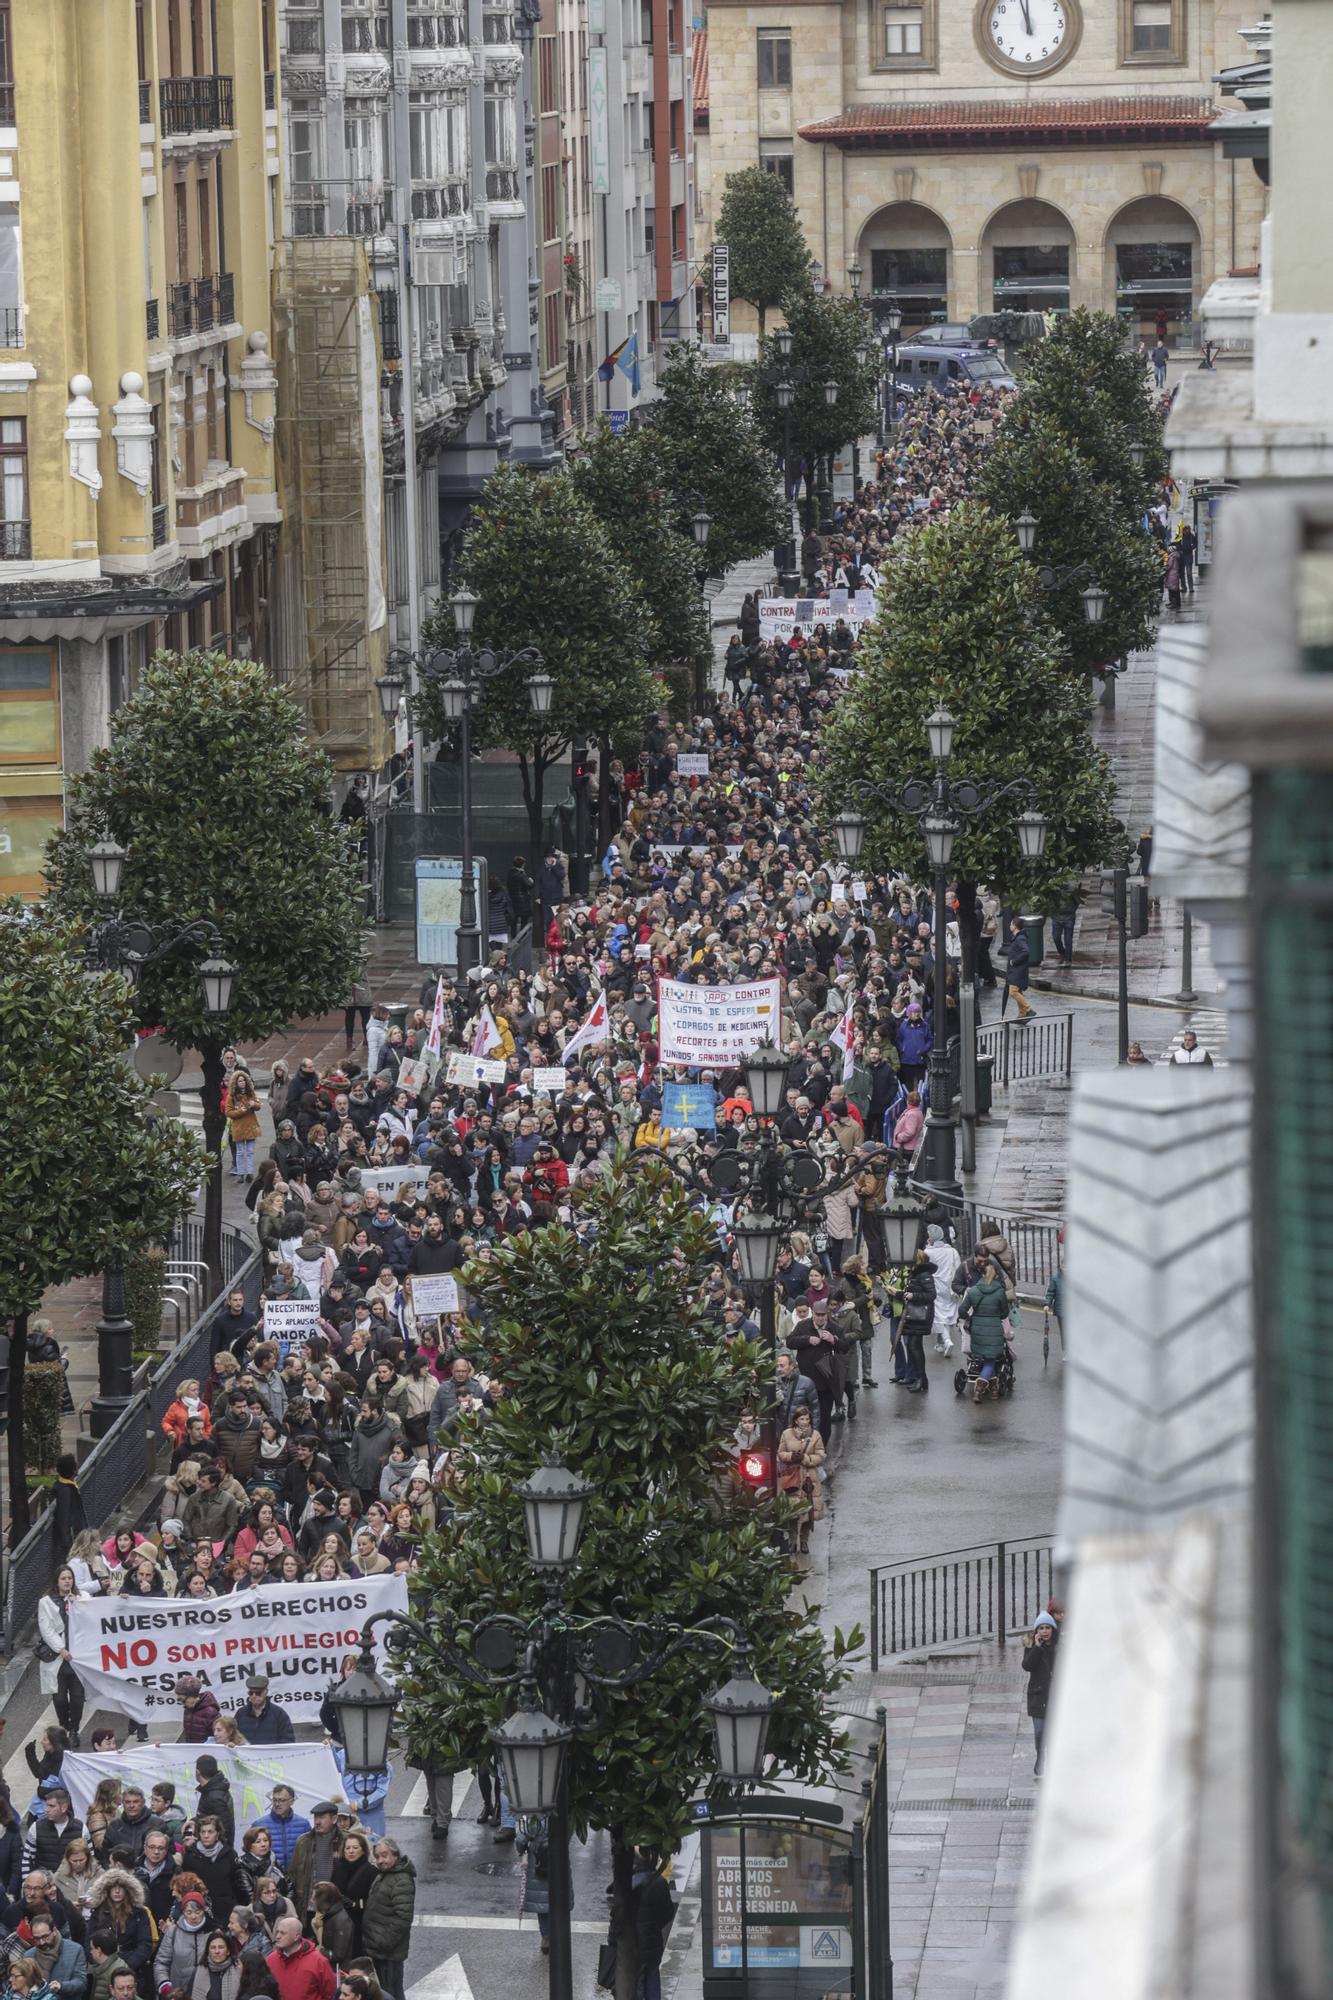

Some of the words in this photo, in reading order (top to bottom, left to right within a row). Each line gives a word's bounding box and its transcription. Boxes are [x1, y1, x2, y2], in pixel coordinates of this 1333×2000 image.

[997, 5, 1006, 14] 10
[1053, 2, 1059, 12] 2
[992, 21, 999, 29] 9
[1057, 19, 1064, 29] 3
[997, 36, 1003, 46] 8
[1052, 36, 1059, 45] 4
[1008, 46, 1015, 56] 7
[1042, 47, 1048, 57] 5
[1025, 53, 1032, 61] 6
[592, 51, 608, 191] FAVILA
[714, 246, 728, 343] Cafeteria
[760, 607, 796, 617] CONTRA
[774, 622, 793, 633] POR
[735, 988, 771, 999] CONTRA
[709, 1007, 721, 1016] DE
[726, 1006, 756, 1016] ESPERA
[717, 1022, 727, 1032] DE
[676, 1036, 717, 1047] RECORTES
[722, 1039, 728, 1047] A
[733, 1039, 744, 1047] LA
[698, 1053, 729, 1062] SANIDAD
[377, 1182, 395, 1191] EN
[267, 1318, 282, 1326] TUS
[111, 1571, 123, 1581] NO
[101, 1608, 232, 1635] NUESTROS
[241, 1592, 368, 1619] DERECHOS
[100, 1638, 158, 1672] NO
[167, 1641, 217, 1663] SON
[225, 1630, 375, 1656] PRIVILEGIO
[220, 1662, 256, 1684] EN
[696, 1803, 708, 1815] C1
[764, 1858, 786, 1866] cerca
[717, 1870, 773, 1883] ABRMOS
[717, 1885, 733, 1898] EN
[717, 1900, 734, 1913] LA
